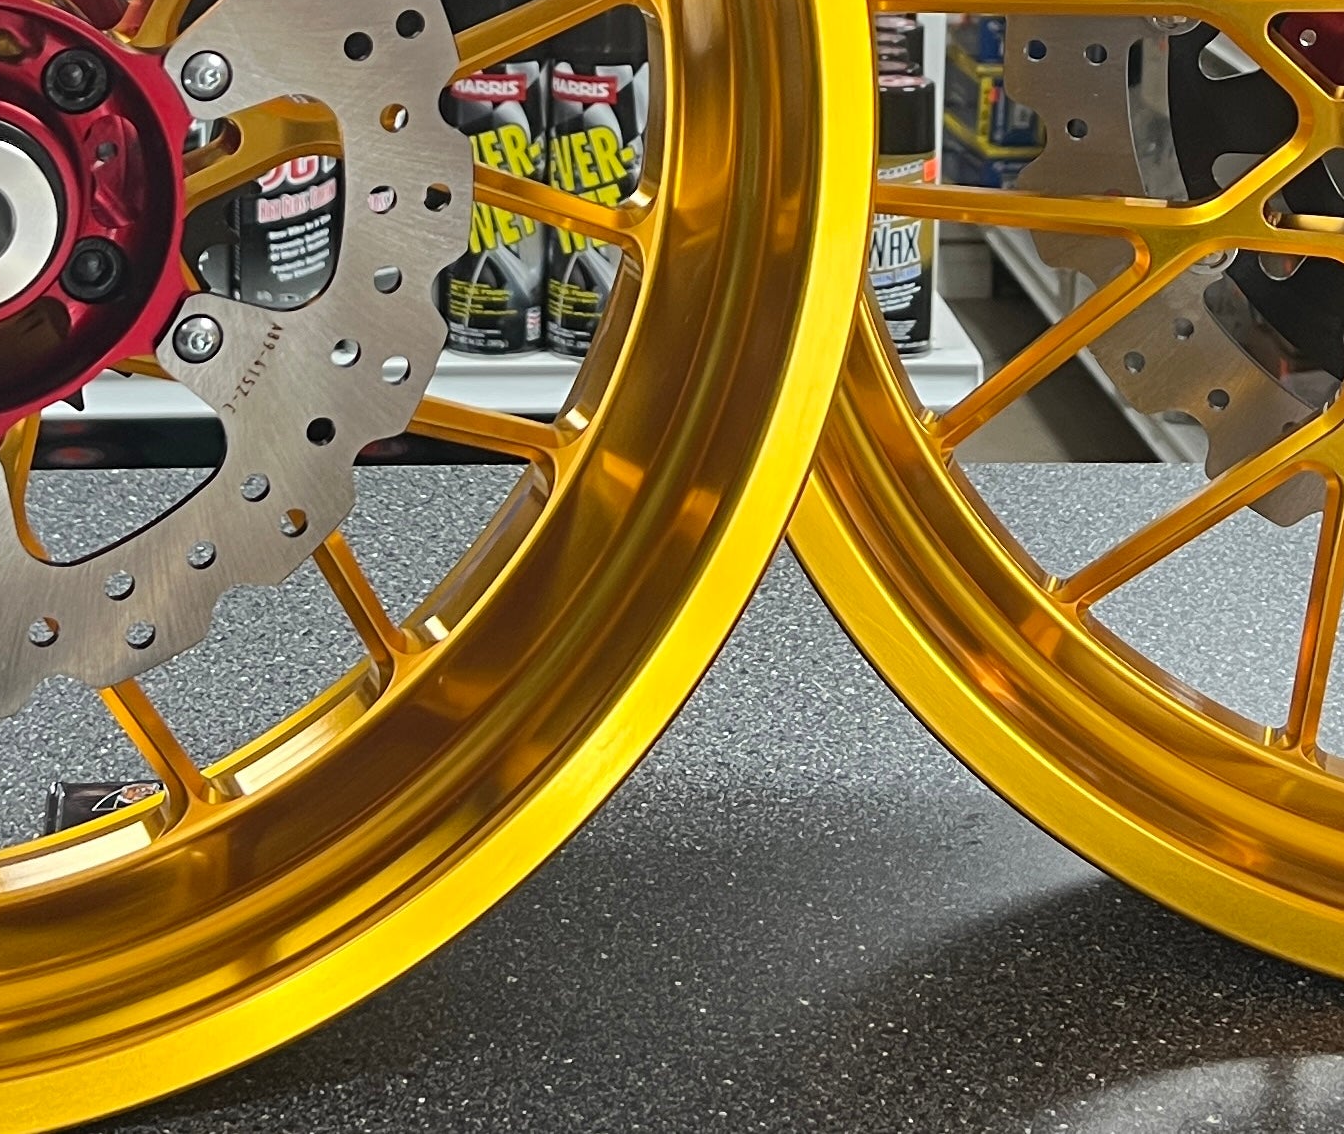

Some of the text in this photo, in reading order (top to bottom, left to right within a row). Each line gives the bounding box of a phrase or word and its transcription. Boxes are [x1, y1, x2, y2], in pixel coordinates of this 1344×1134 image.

[454, 76, 520, 97] HARRIS
[552, 77, 610, 98] HARRIS
[869, 222, 920, 269] WAX
